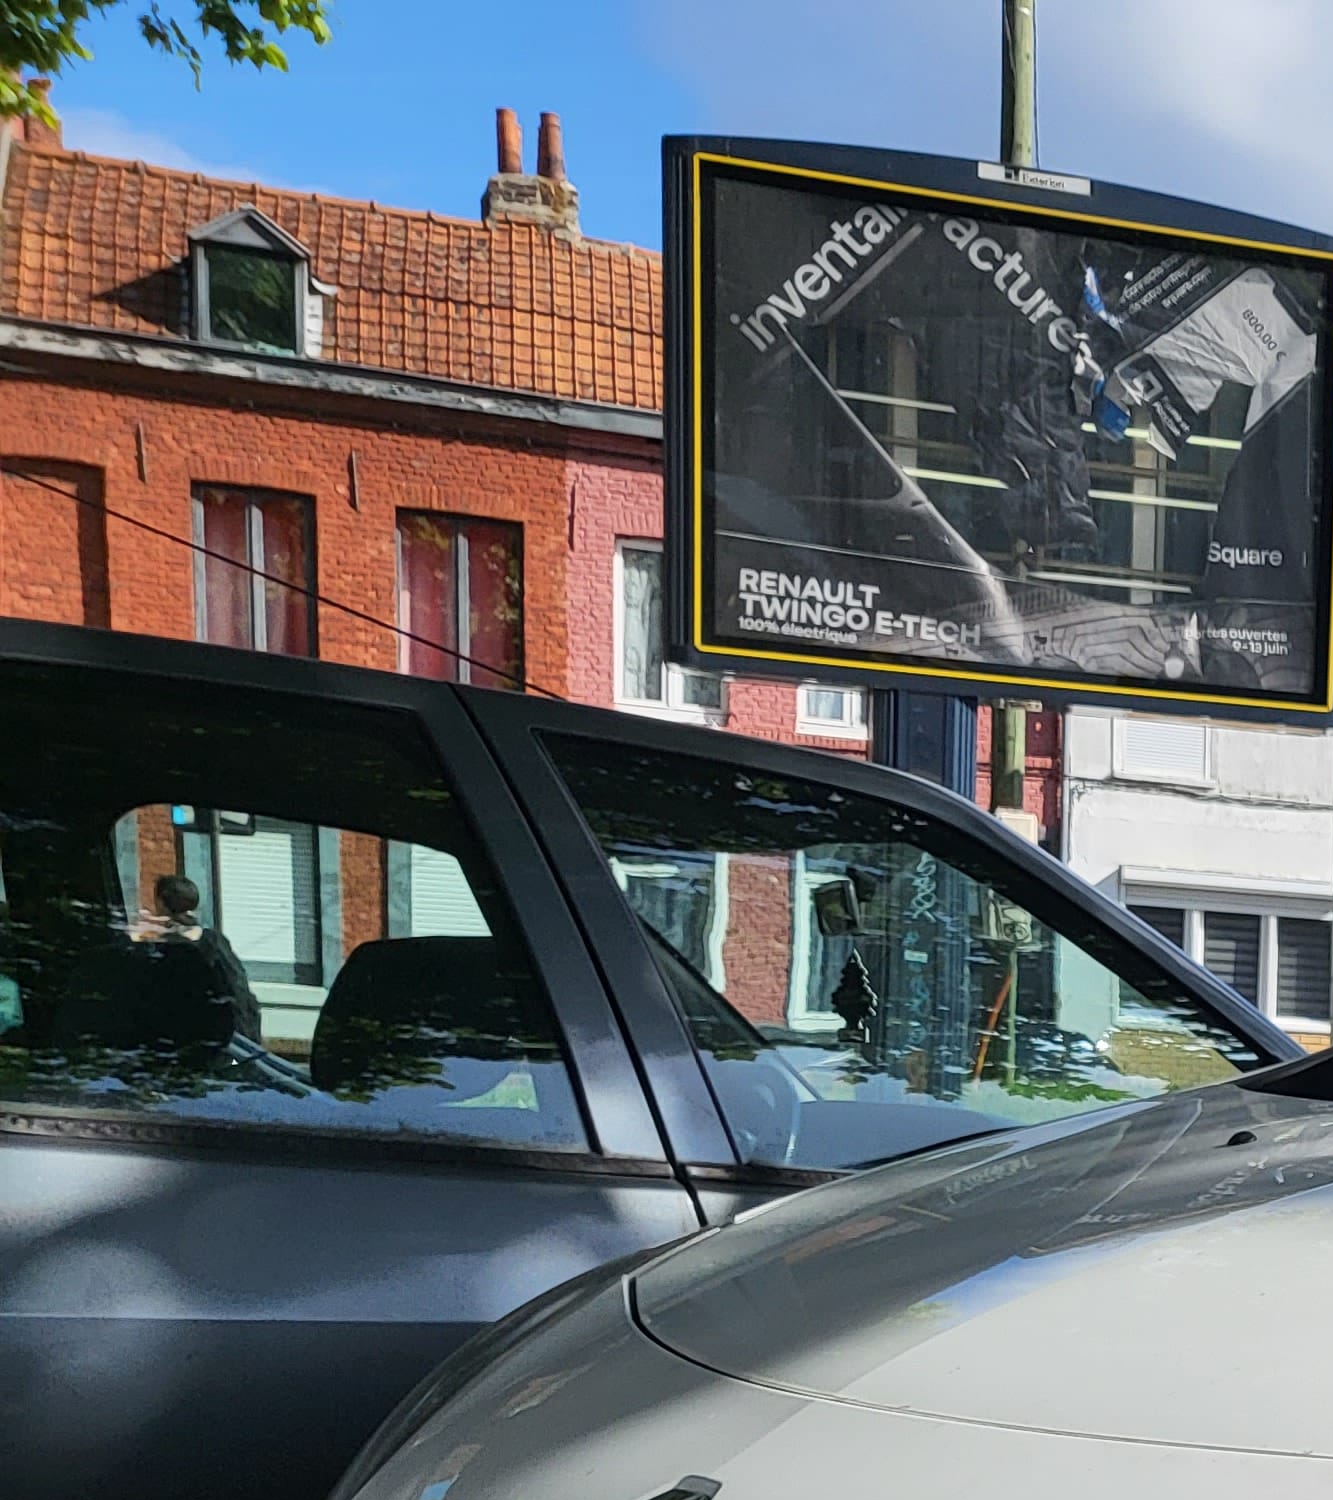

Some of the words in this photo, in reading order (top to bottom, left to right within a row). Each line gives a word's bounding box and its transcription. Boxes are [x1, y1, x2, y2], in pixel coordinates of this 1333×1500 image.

[729, 203, 908, 352] inventai
[1207, 541, 1283, 568] Square
[739, 568, 881, 609] RENAULT
[738, 616, 780, 634] 100%
[739, 592, 870, 631] TWINGO
[875, 611, 982, 646] E-TECH
